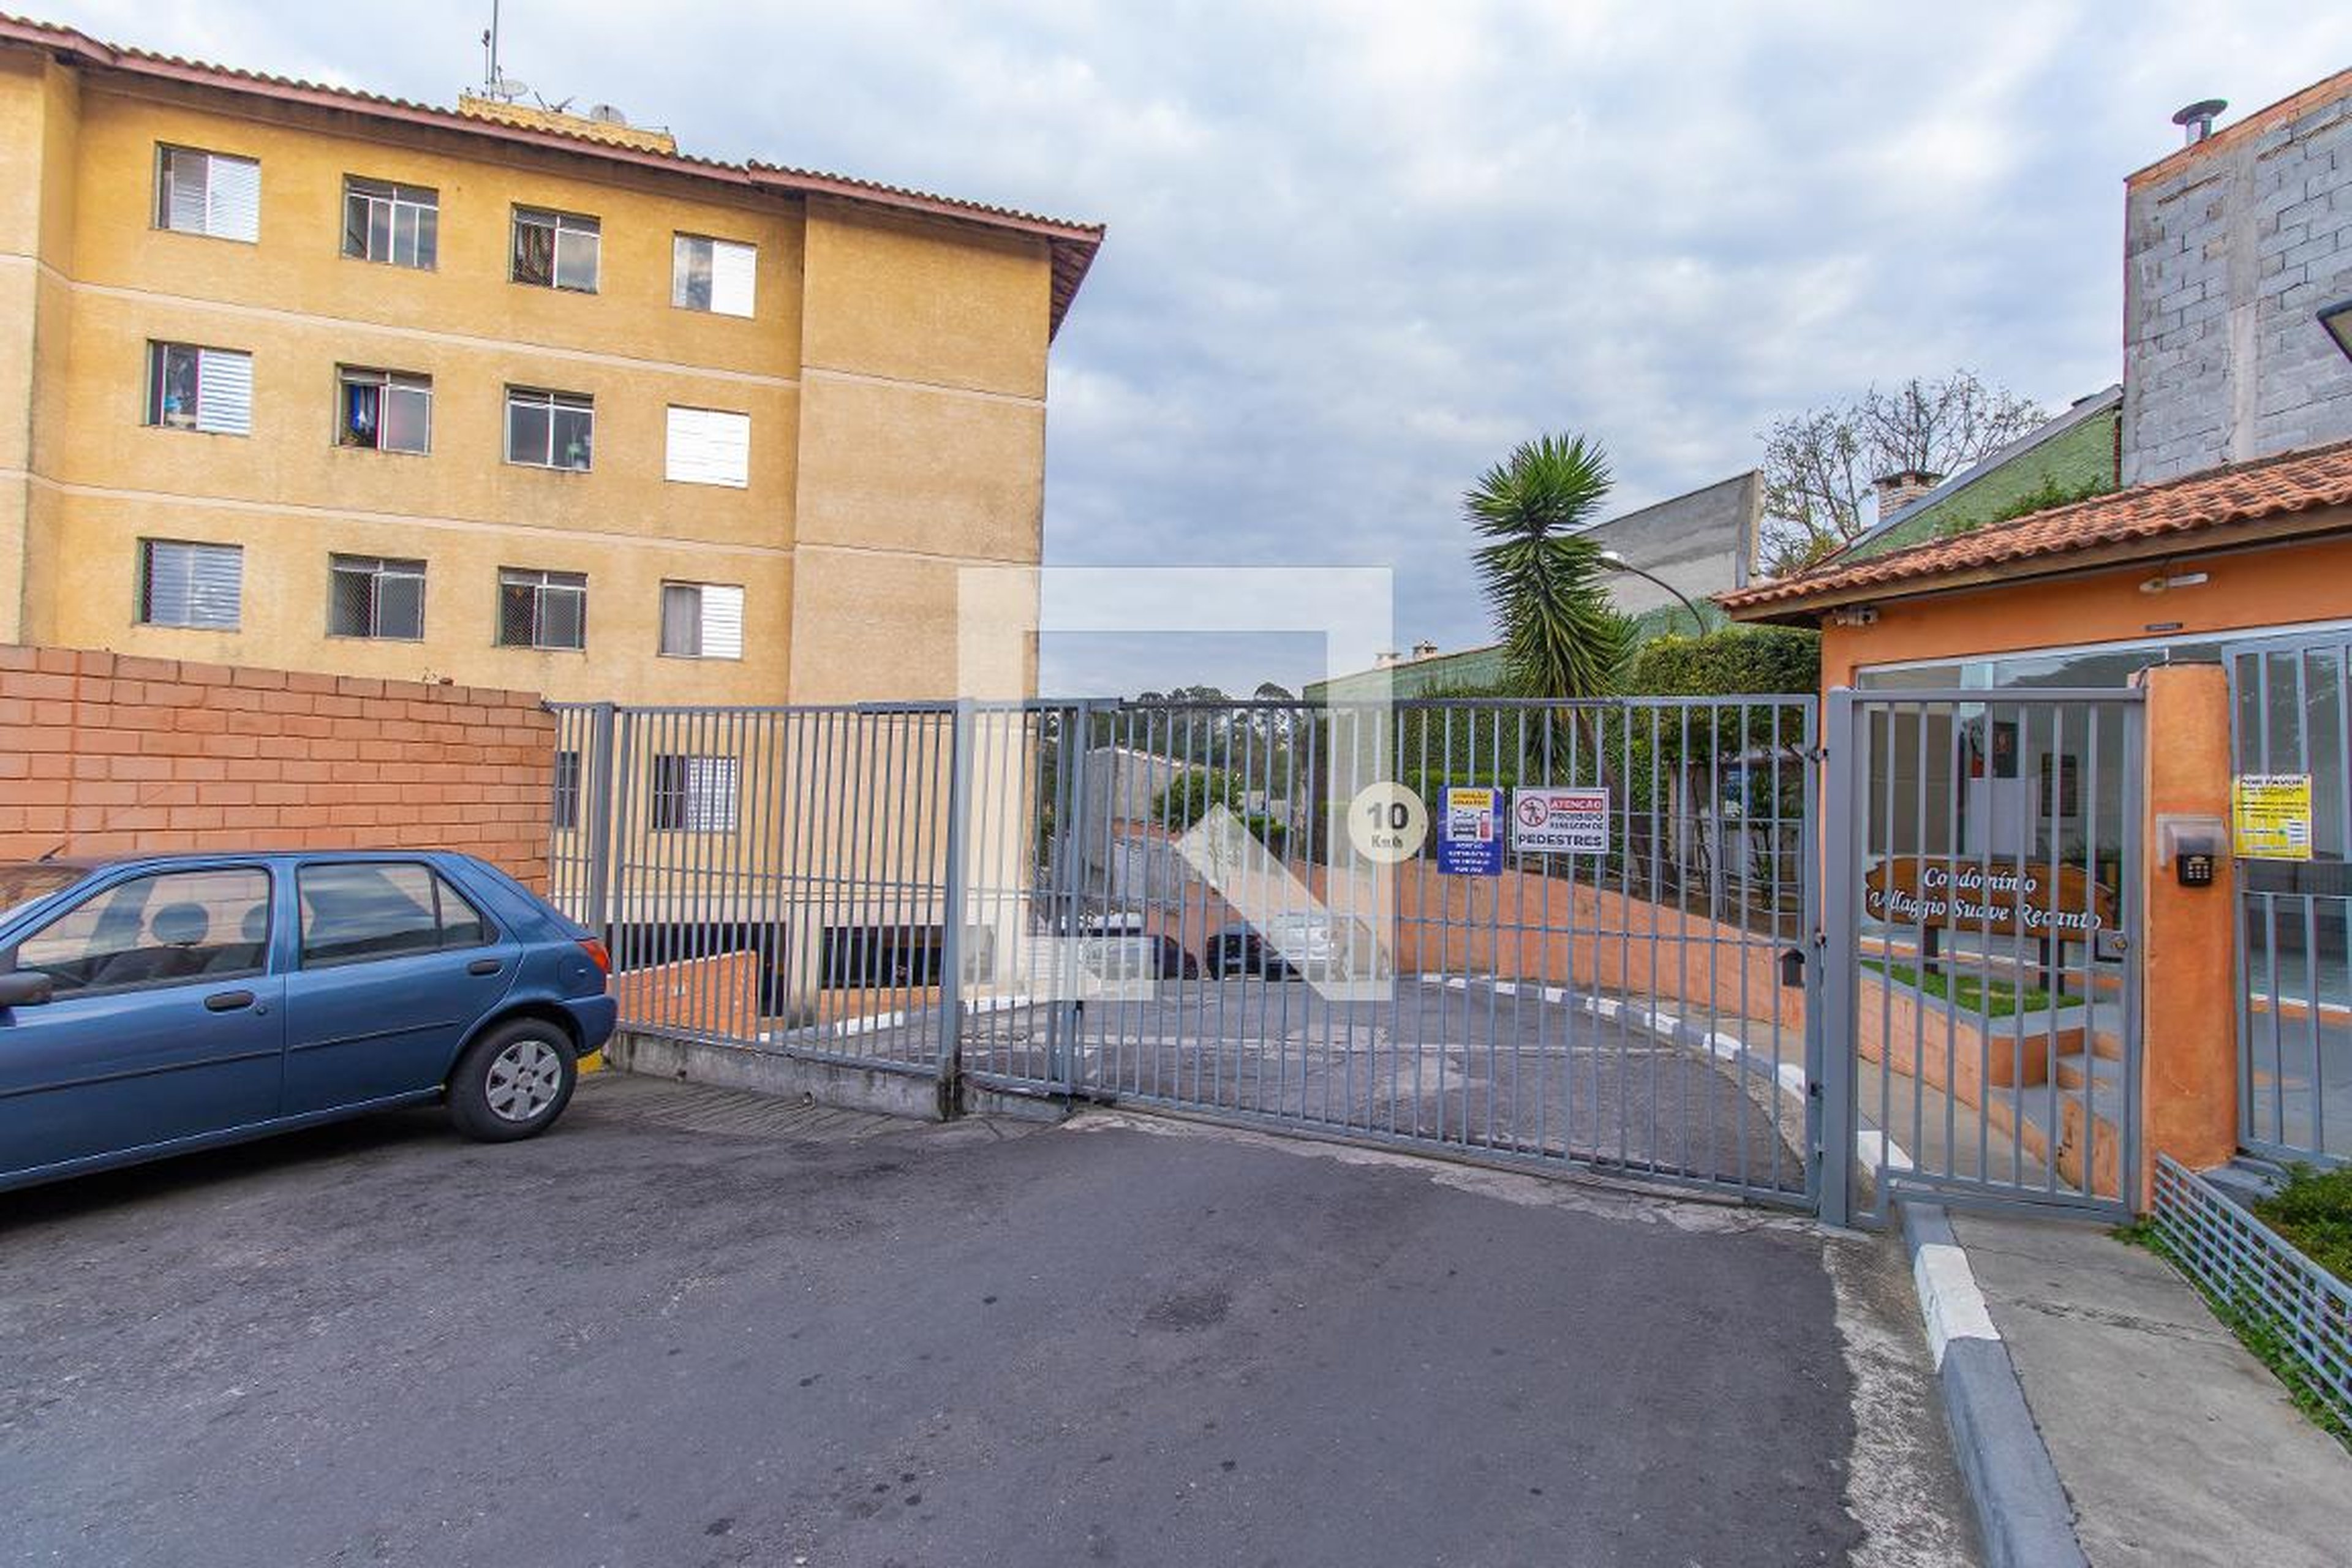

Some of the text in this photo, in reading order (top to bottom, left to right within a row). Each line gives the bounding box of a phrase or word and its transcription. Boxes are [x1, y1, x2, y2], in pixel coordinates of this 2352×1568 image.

[1367, 802, 1409, 829] 10
[1518, 834, 1602, 846] PEDESTRES
[1924, 866, 2037, 892] Codomíno
